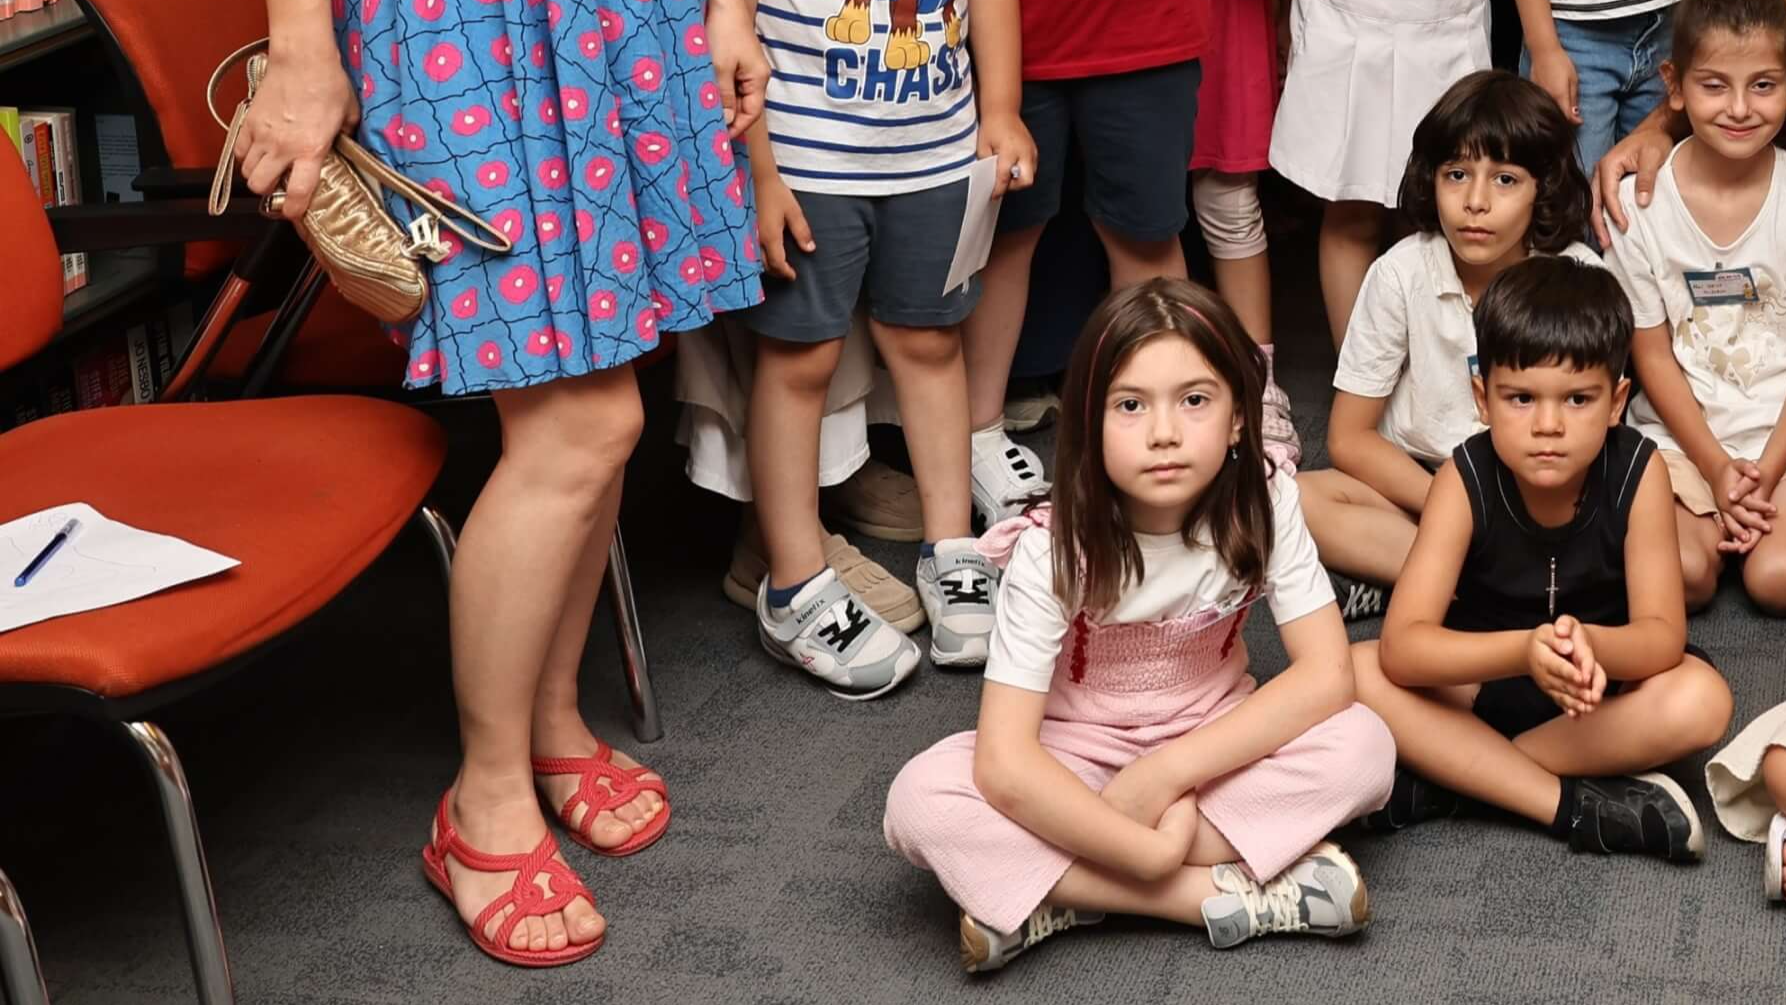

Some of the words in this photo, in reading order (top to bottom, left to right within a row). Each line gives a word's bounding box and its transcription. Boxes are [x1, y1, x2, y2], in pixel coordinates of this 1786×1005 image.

[824, 44, 964, 104] CHASE
[133, 340, 147, 357] JO
[955, 556, 986, 568] kinetix
[795, 597, 827, 625] kinetix
